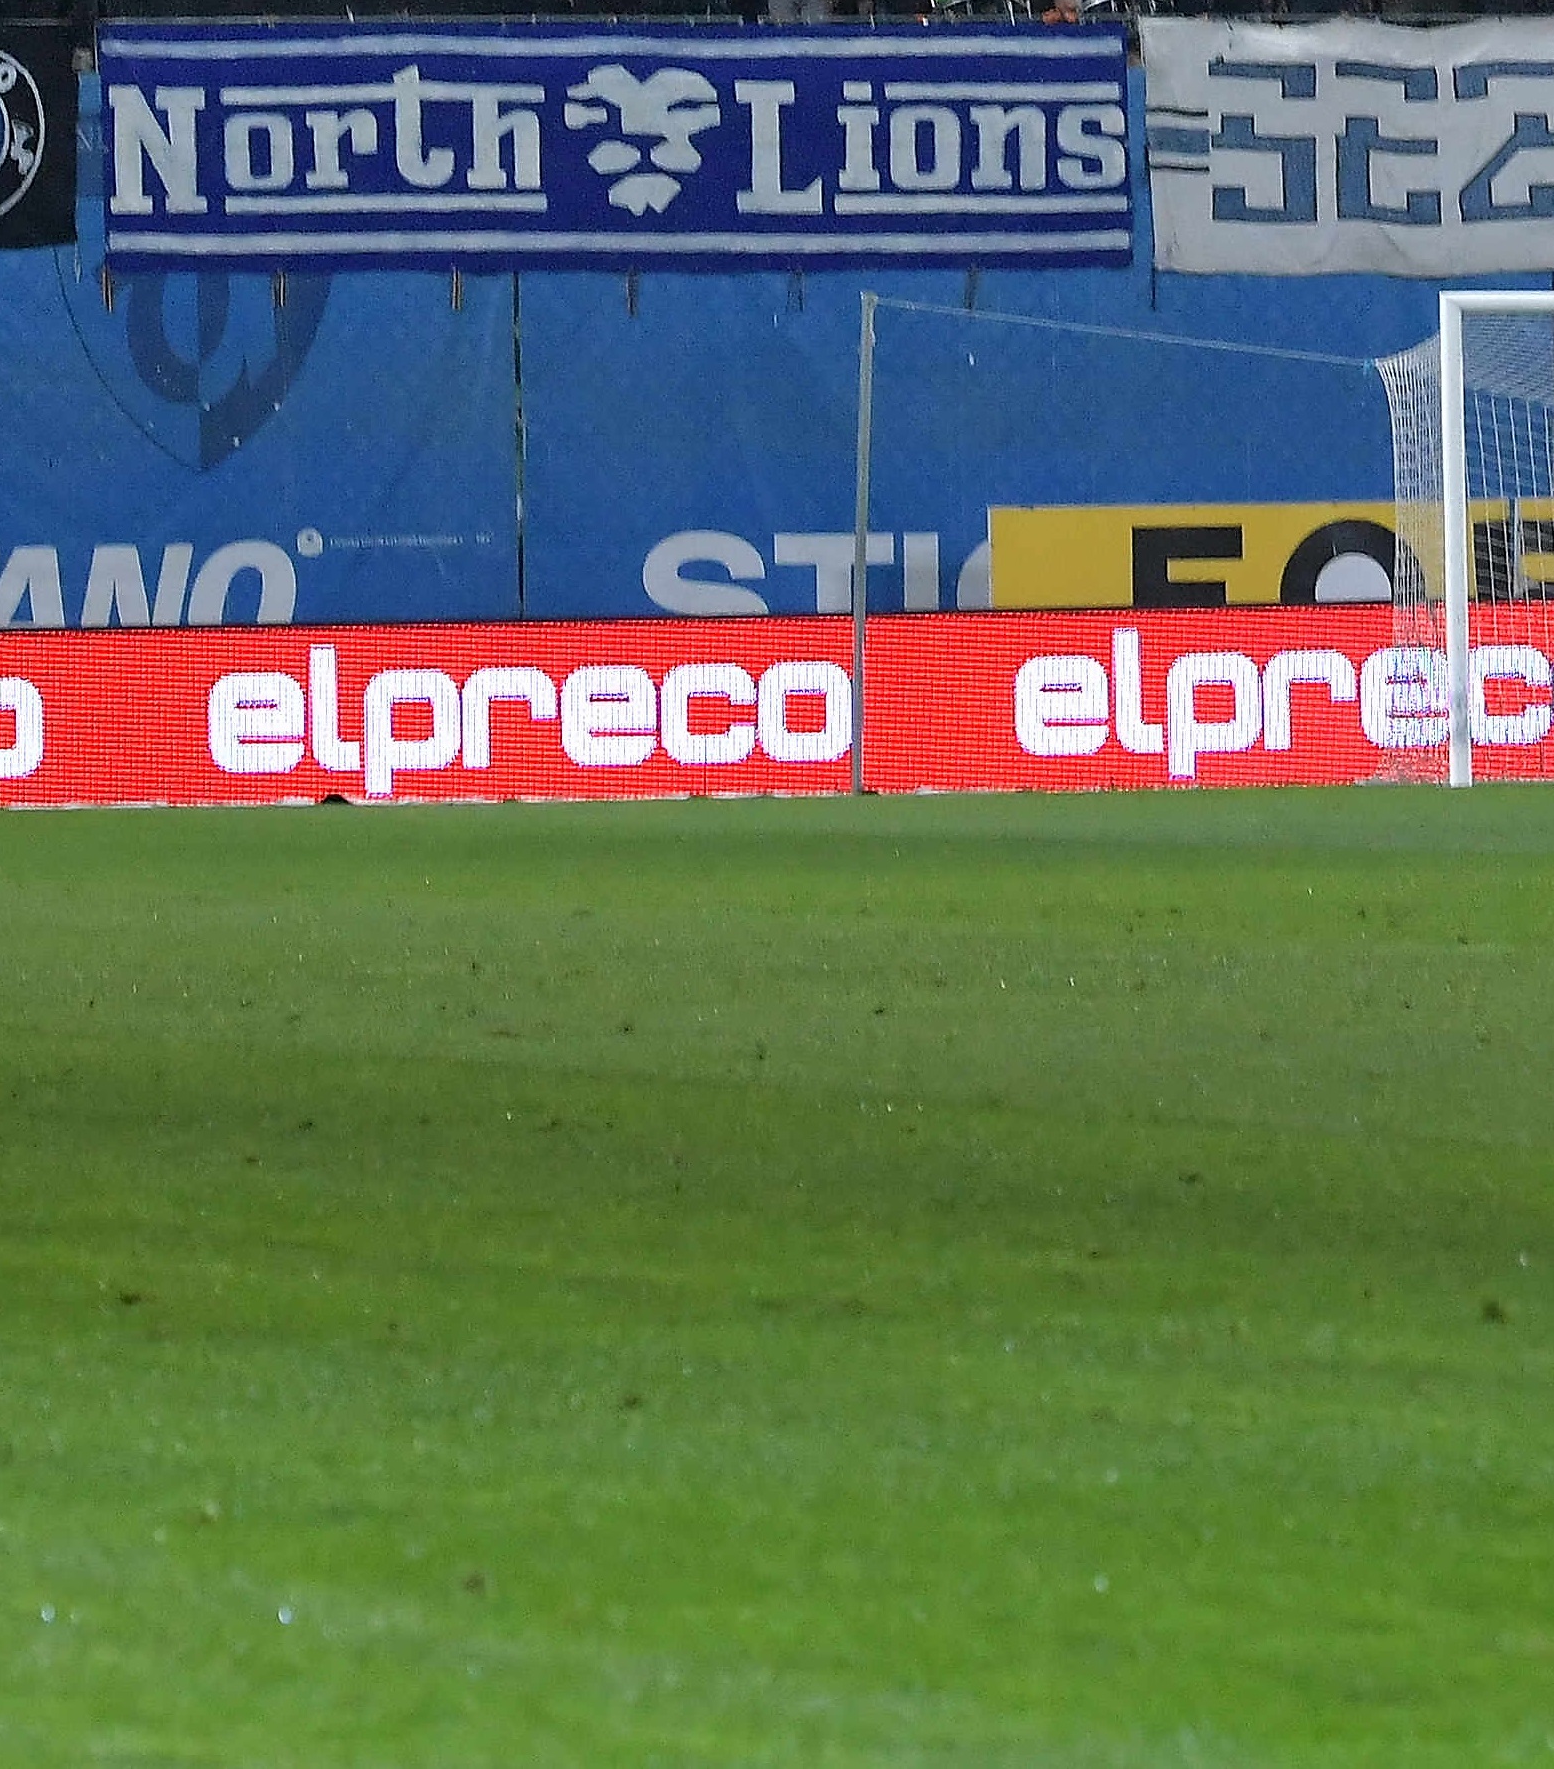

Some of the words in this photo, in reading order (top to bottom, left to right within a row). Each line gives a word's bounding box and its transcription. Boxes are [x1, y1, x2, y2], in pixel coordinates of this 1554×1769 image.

[109, 66, 542, 215] North
[736, 79, 1126, 215] Lions
[642, 528, 991, 617] STI
[207, 643, 853, 800] elpreco
